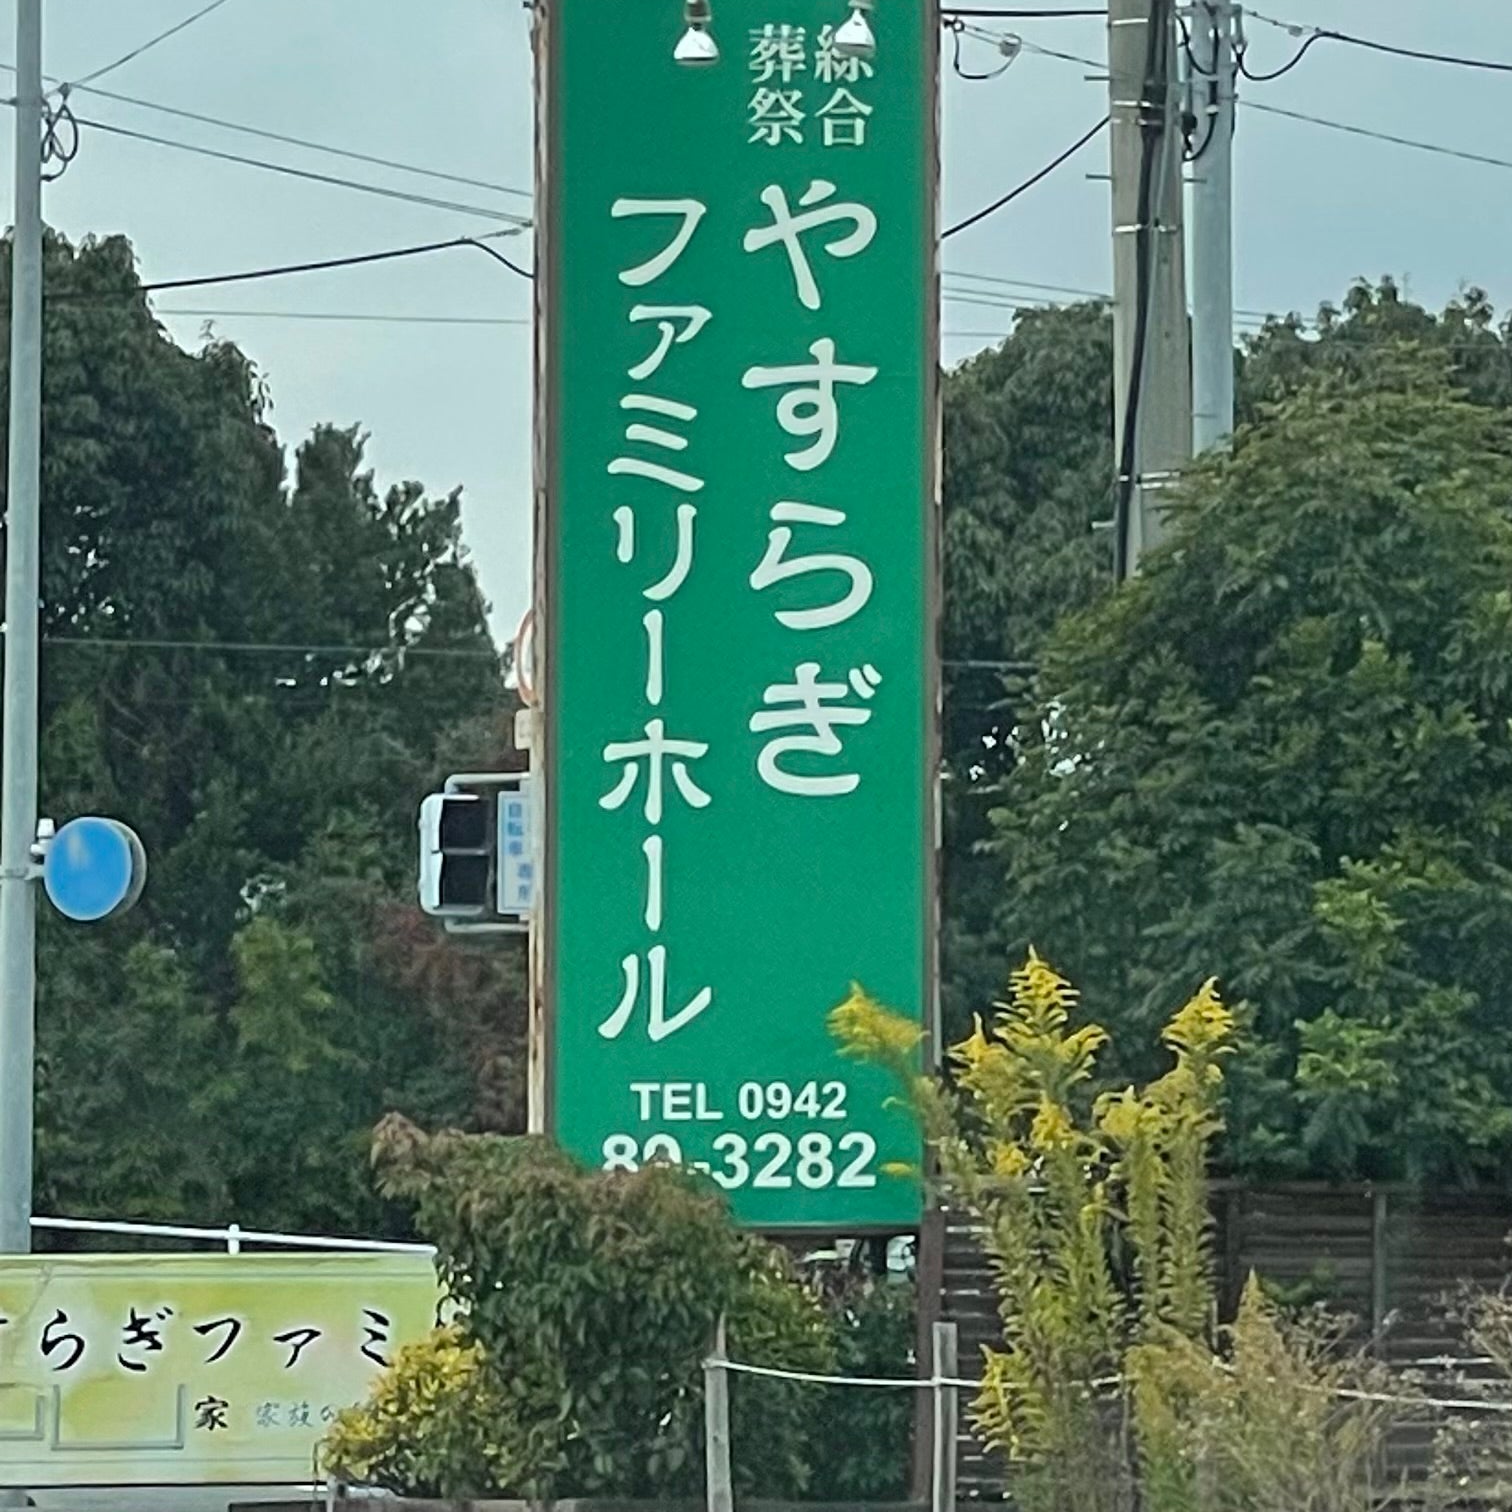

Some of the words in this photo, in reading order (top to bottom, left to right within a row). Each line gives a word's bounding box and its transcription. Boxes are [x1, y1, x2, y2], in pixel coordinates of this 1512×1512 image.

[748, 23, 807, 146] 葬祭
[741, 179, 882, 796] やすらぎ
[598, 198, 712, 1042] ファミリーホール
[630, 1082, 723, 1121] TEL
[738, 1081, 847, 1120] 0942
[0, 1306, 391, 1372] らぎファミ
[195, 1395, 229, 1431] 家
